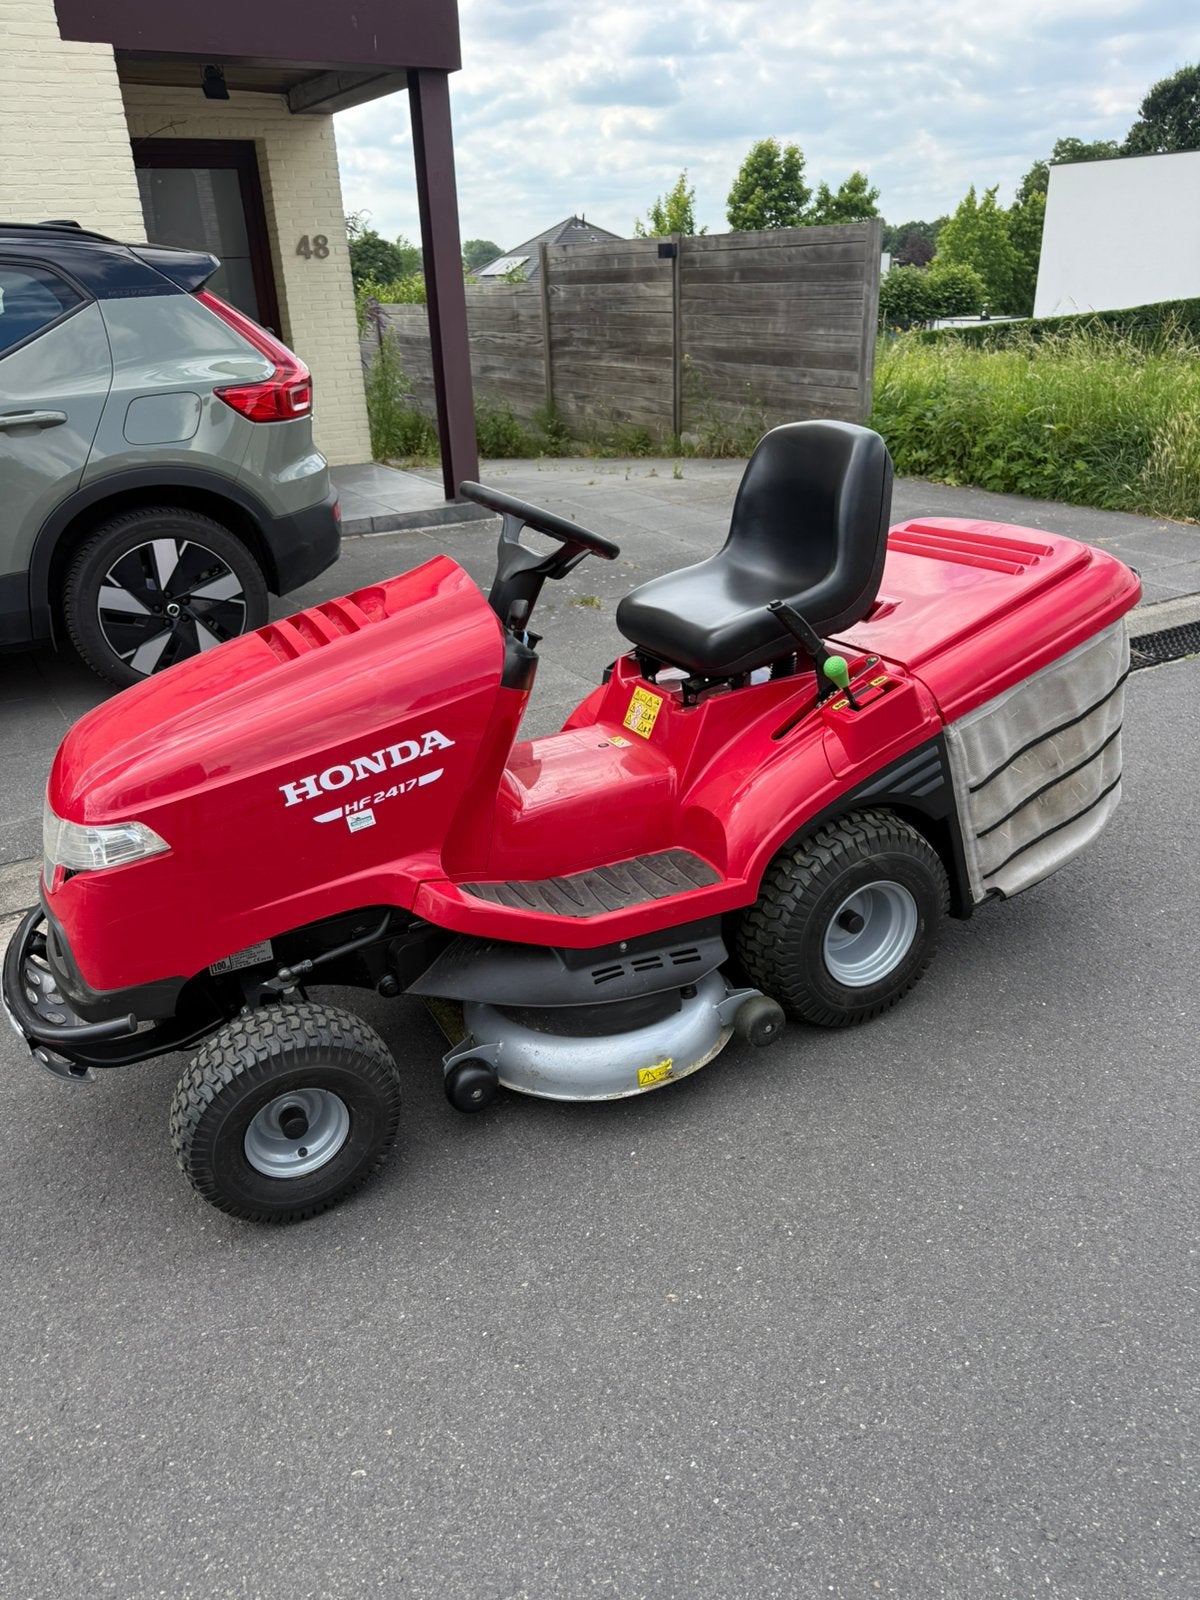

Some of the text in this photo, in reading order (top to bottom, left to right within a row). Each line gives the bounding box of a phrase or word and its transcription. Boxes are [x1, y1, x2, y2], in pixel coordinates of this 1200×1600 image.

[296, 234, 329, 259] 48
[279, 730, 456, 807] HONDA
[345, 778, 417, 815] HF 2417
[213, 961, 226, 972] 100
